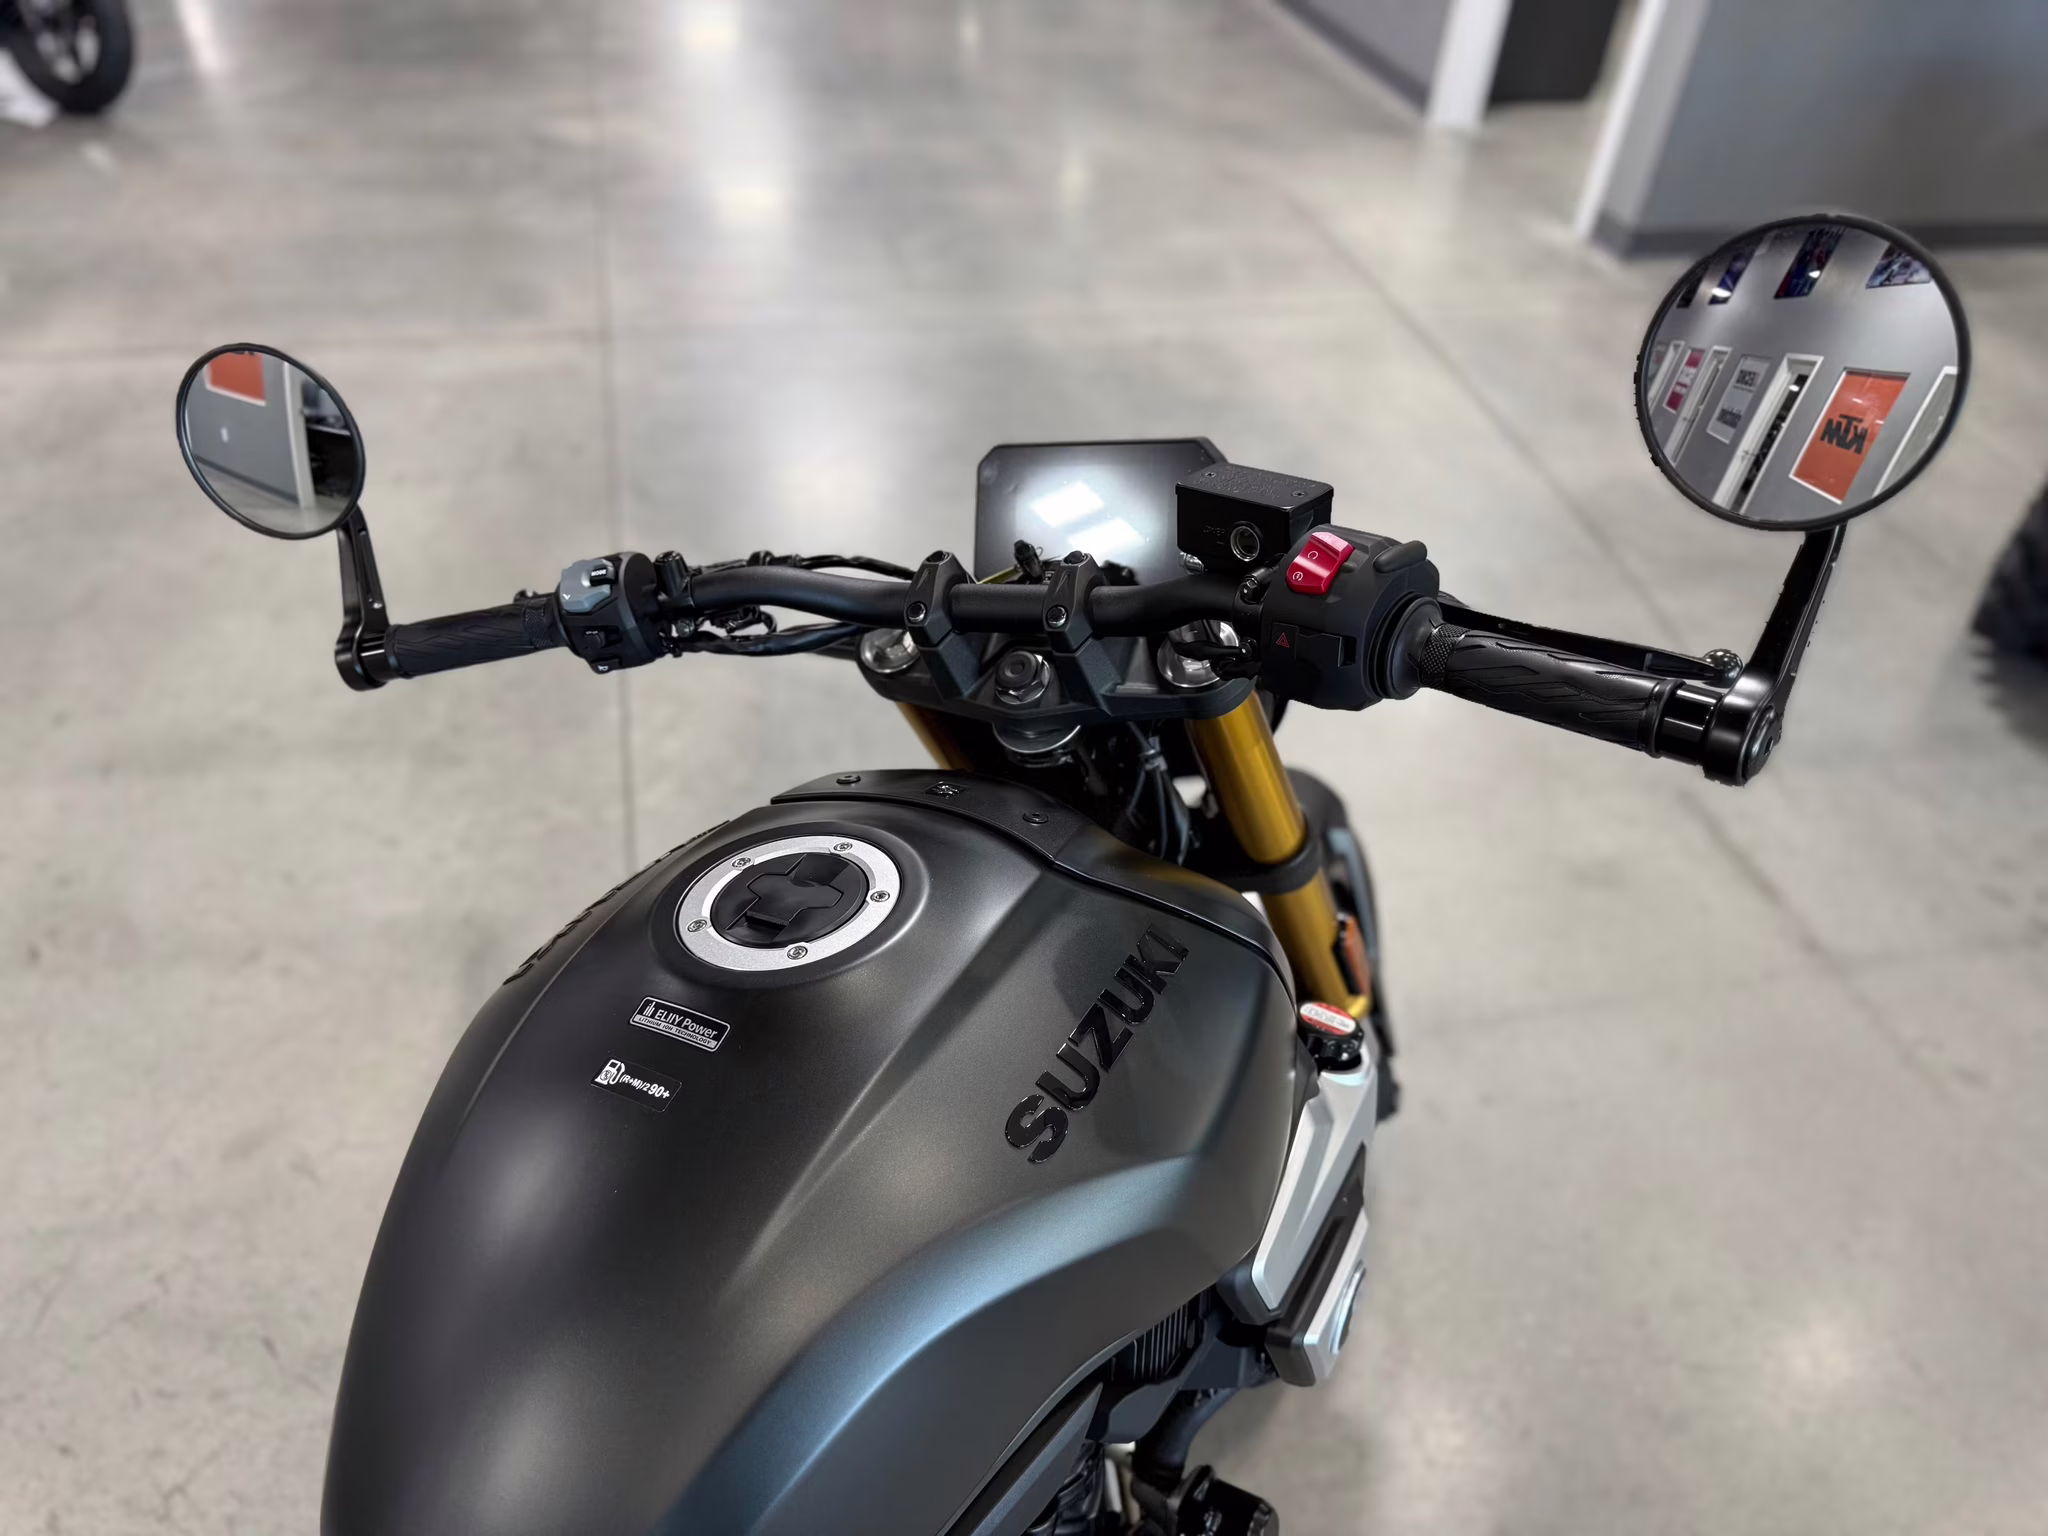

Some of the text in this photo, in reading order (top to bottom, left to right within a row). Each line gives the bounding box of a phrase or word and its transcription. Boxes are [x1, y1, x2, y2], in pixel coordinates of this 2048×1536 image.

[638, 1017, 712, 1045] LITHIUM ION TECHNOLOGY
[681, 1017, 718, 1039] Power
[1005, 925, 1190, 1164] SUZUKI
[648, 1083, 670, 1099] 90+
